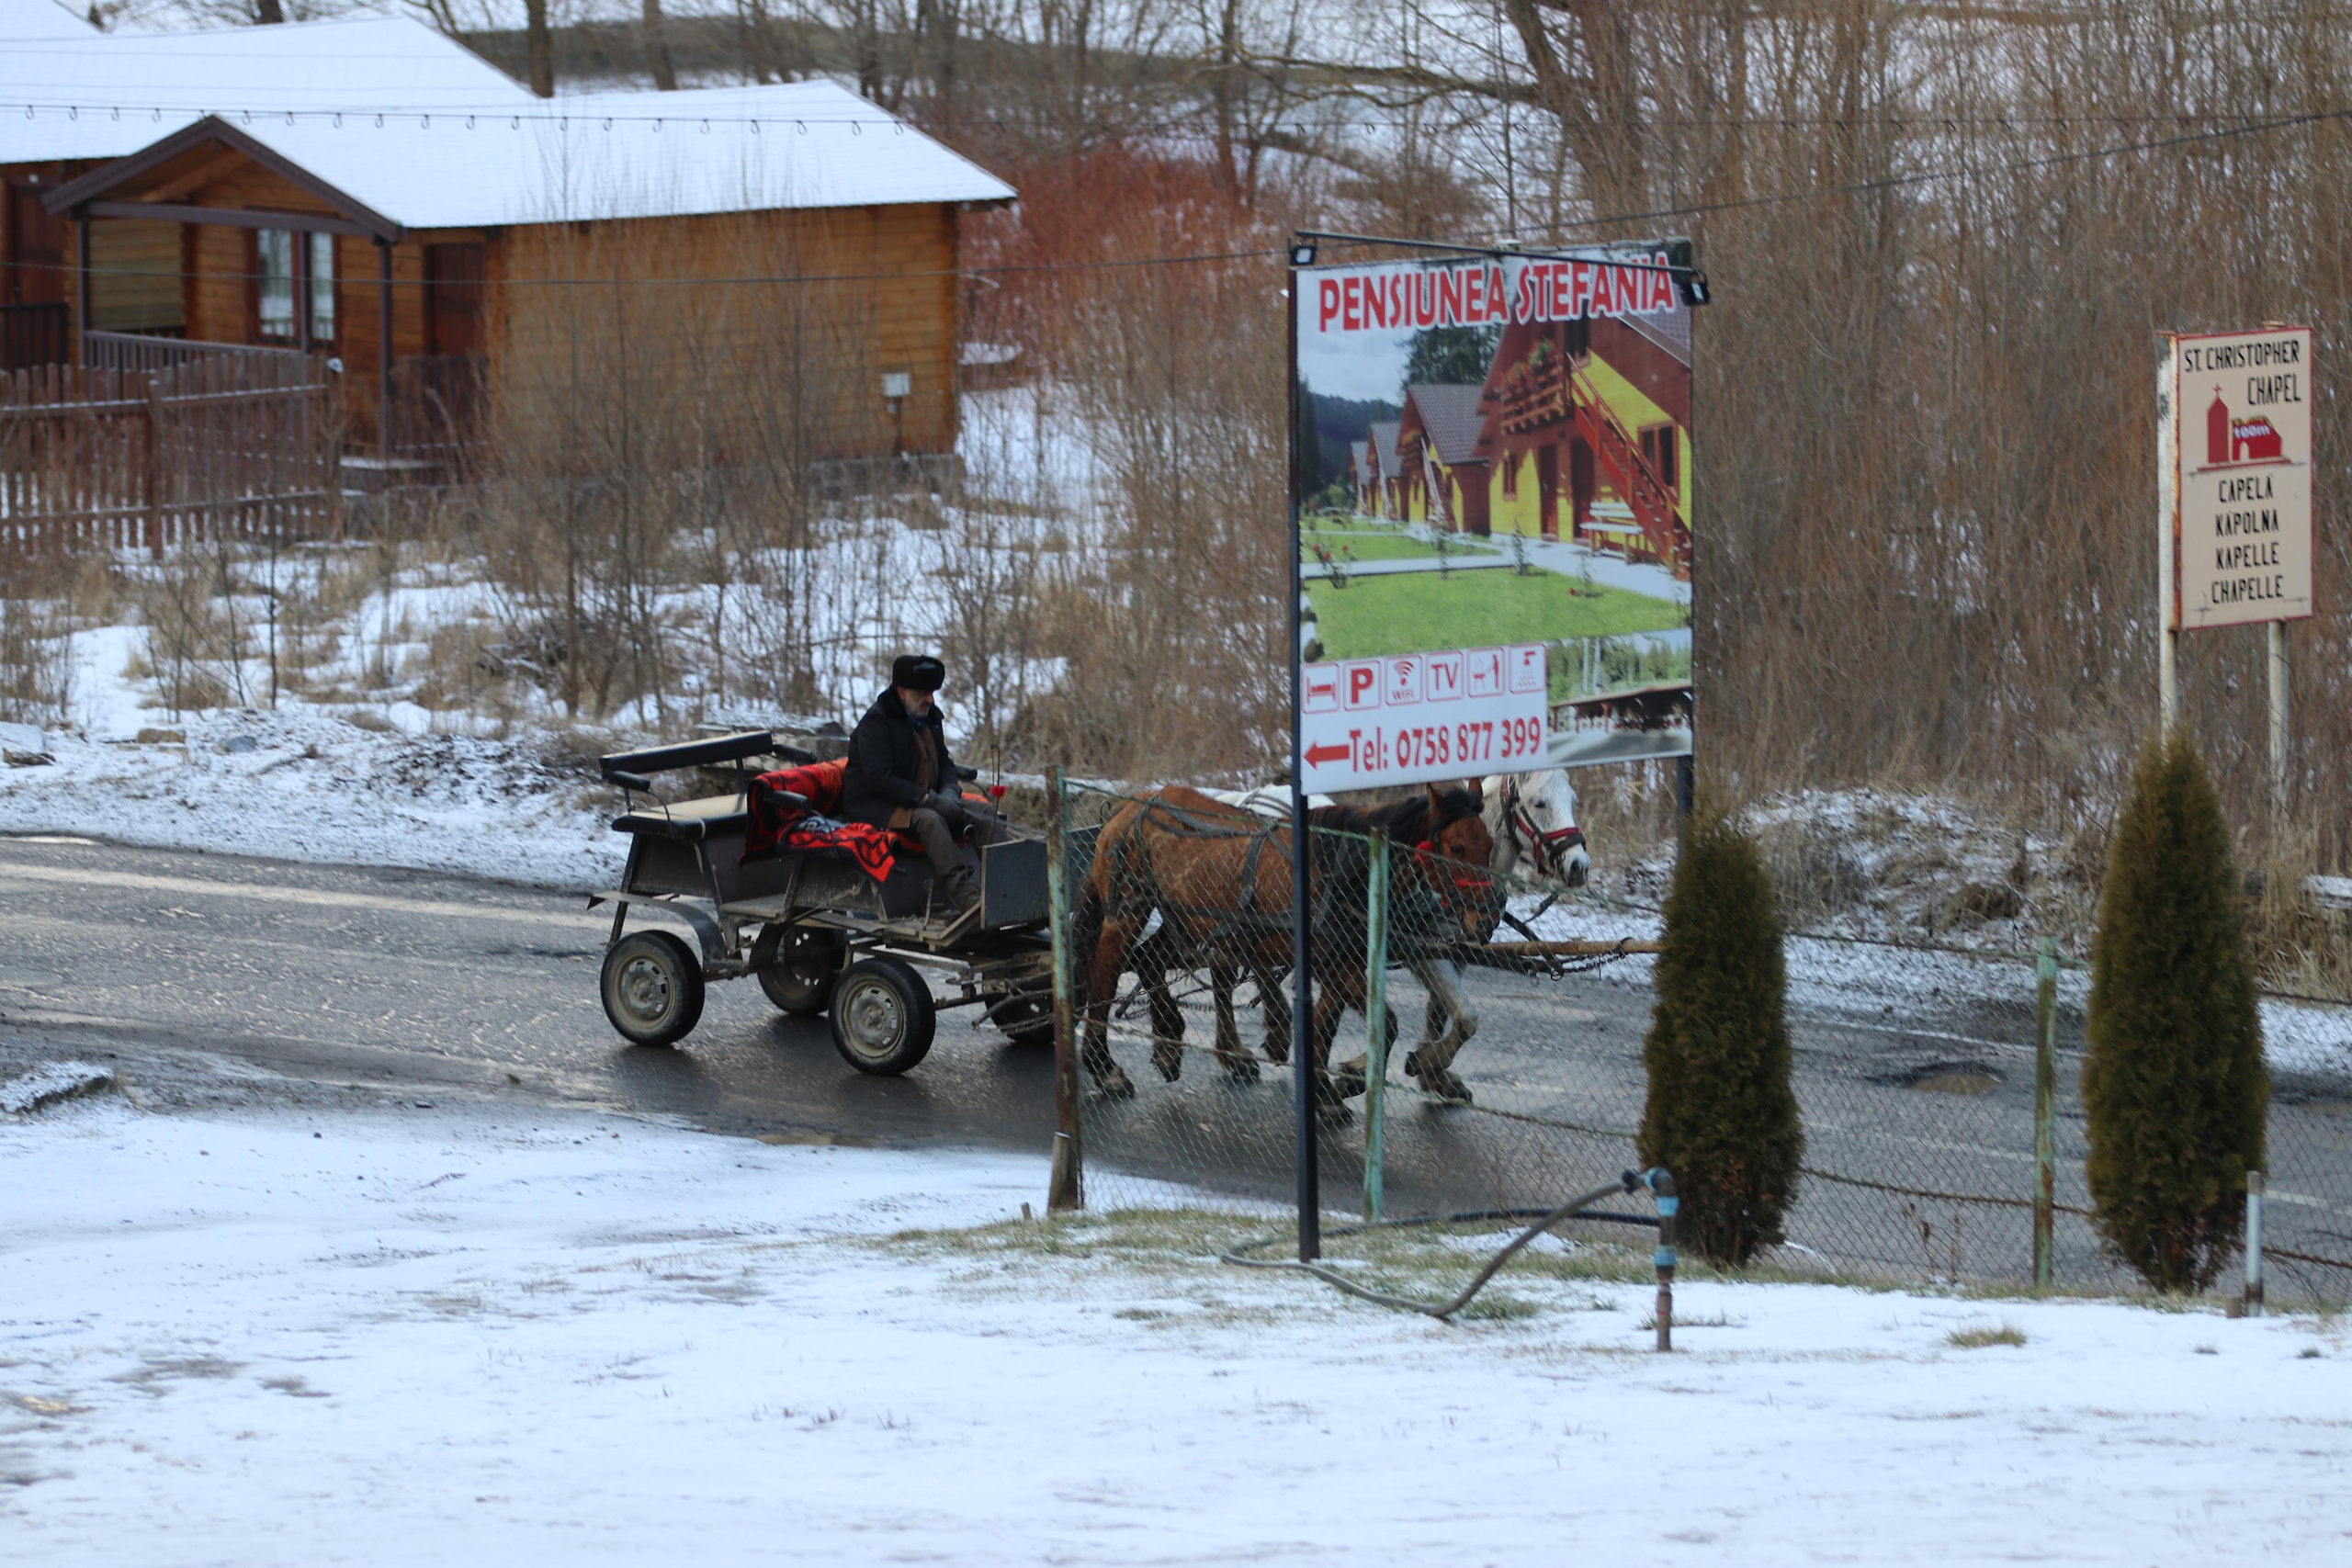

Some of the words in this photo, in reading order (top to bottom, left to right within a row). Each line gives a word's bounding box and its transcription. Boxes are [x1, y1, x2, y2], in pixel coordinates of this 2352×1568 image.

[1318, 265, 1509, 333] PENSIUNEA
[1517, 254, 1675, 323] STEFANIA
[2206, 340, 2300, 370] CHRISTOPHER
[2247, 373, 2301, 405] CHAPEL
[2215, 541, 2280, 570] KAPELLE
[2211, 574, 2284, 604] CHAPELLE
[1351, 668, 1374, 705] P
[1430, 661, 1459, 691] TV
[1349, 726, 1388, 773] Tel:
[1396, 725, 1450, 769] 0758
[1457, 721, 1493, 762] 877
[1500, 716, 1541, 758] 399
